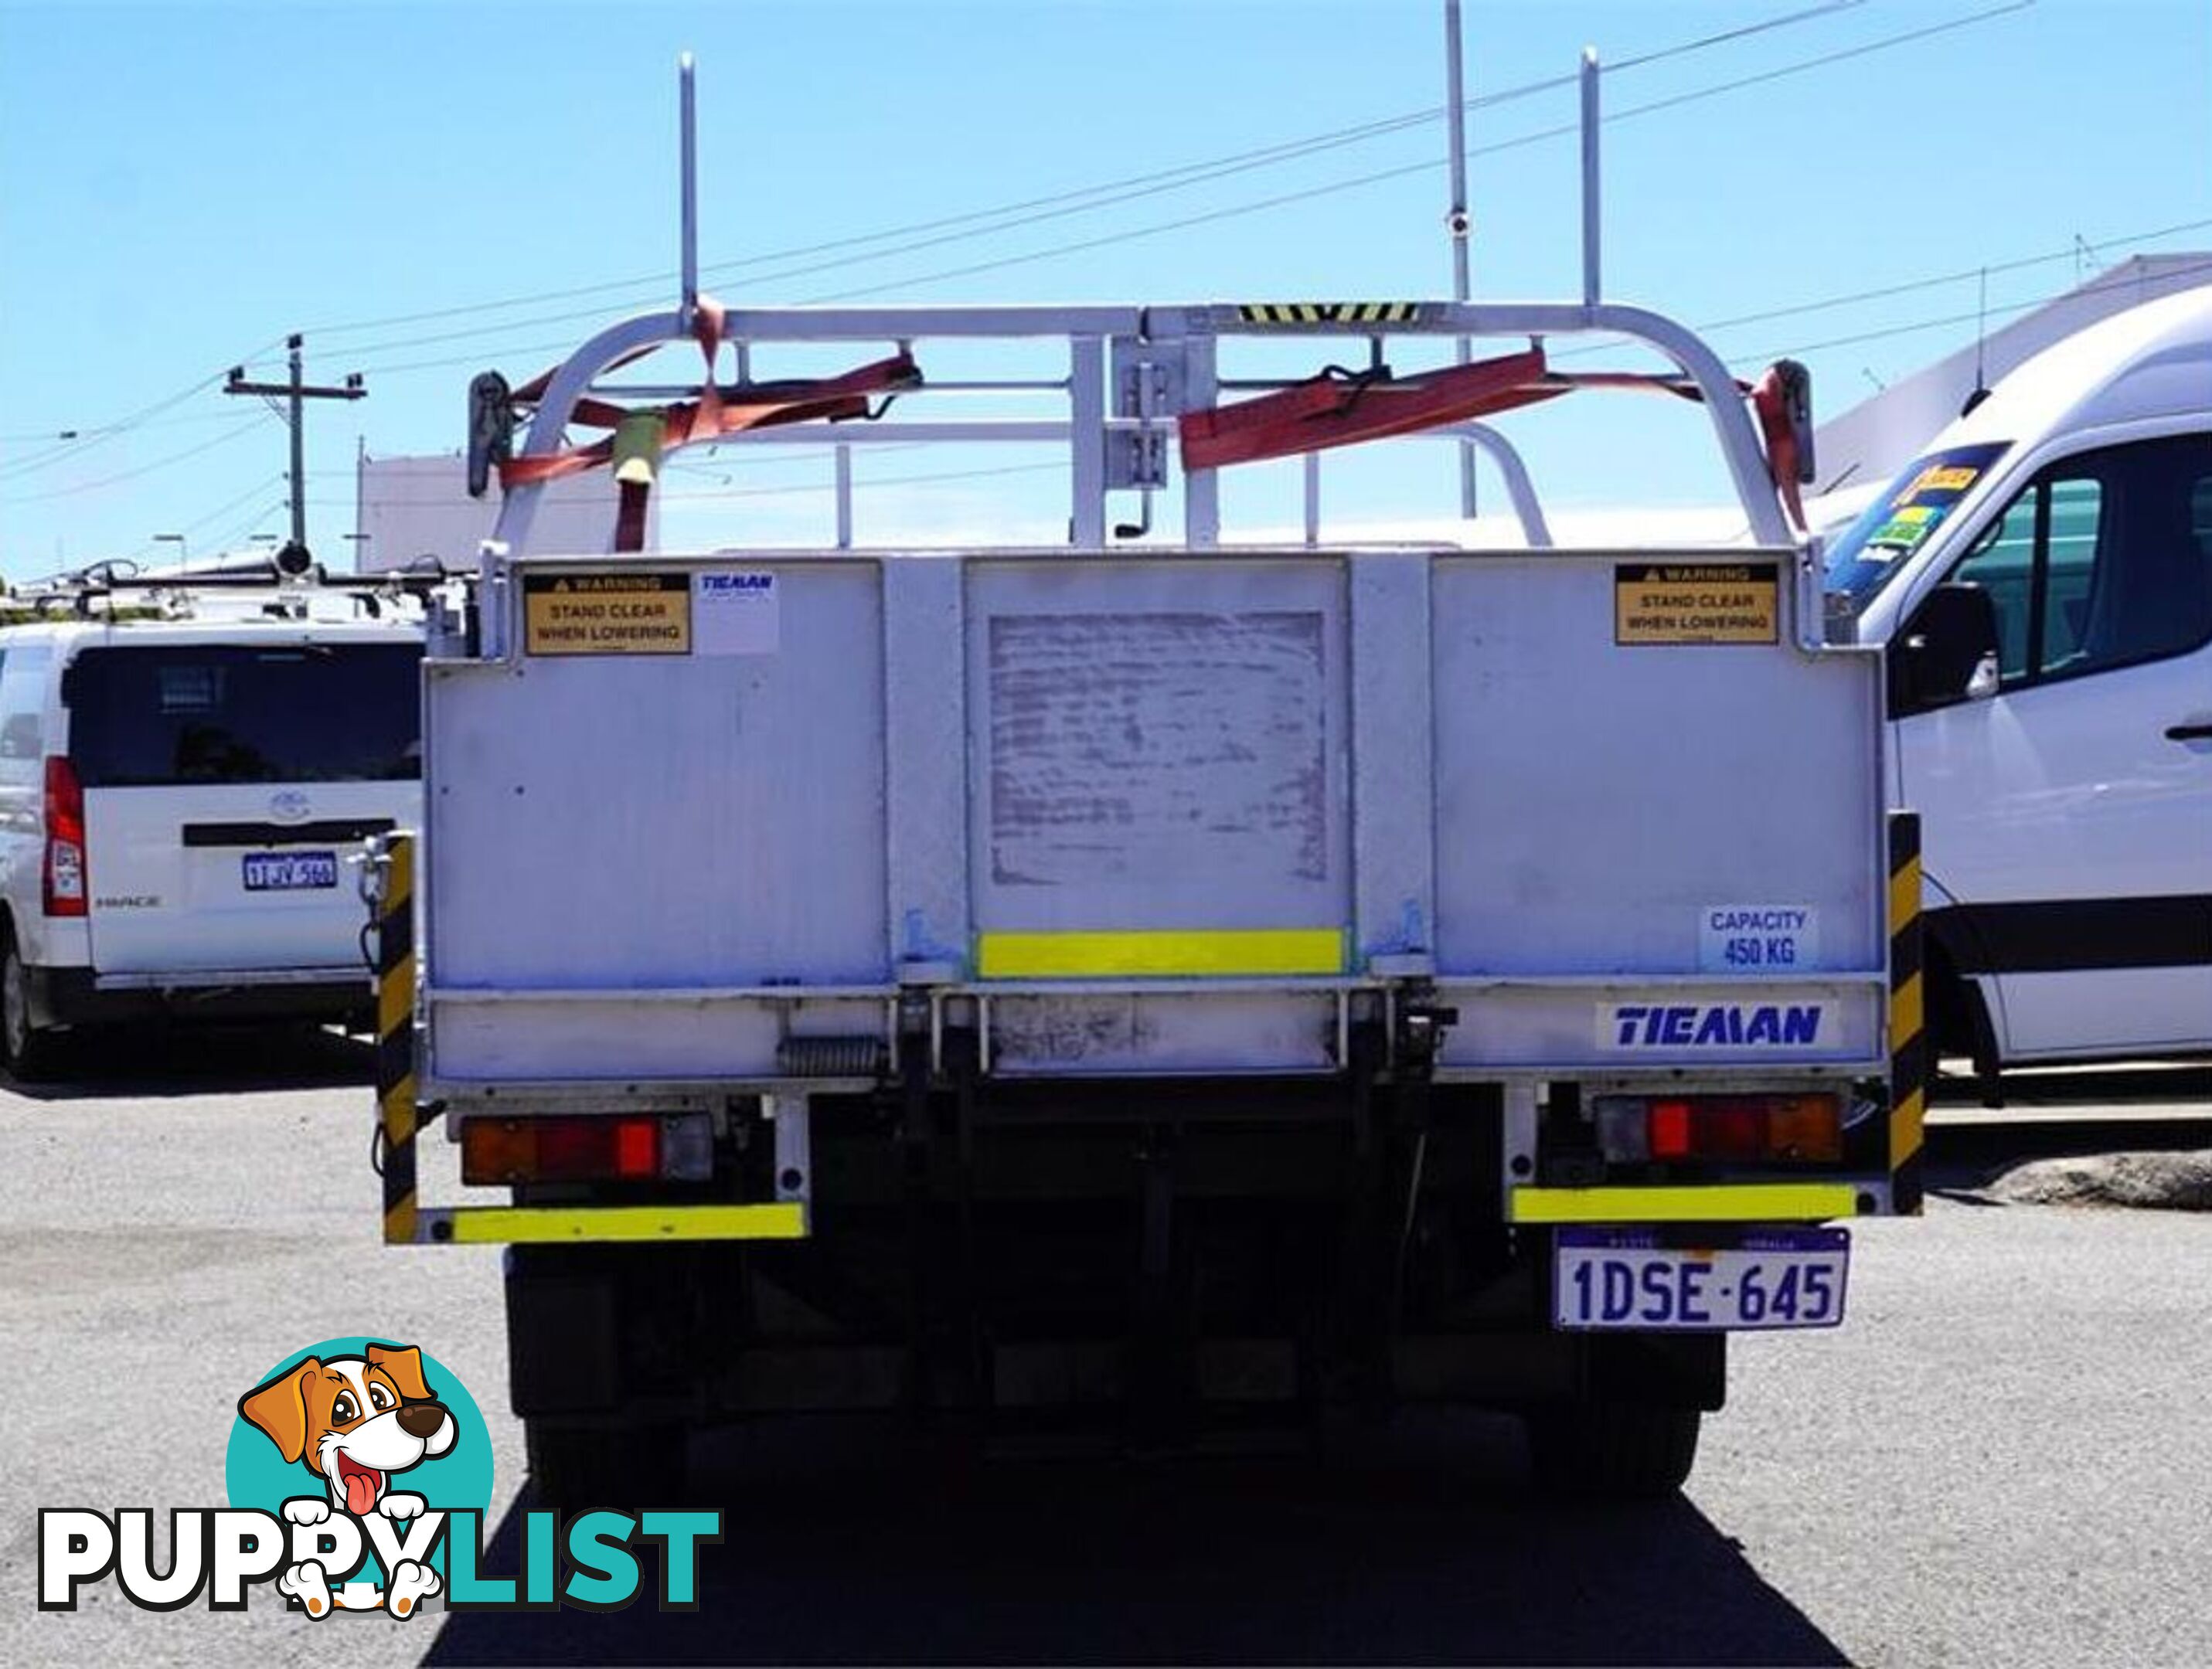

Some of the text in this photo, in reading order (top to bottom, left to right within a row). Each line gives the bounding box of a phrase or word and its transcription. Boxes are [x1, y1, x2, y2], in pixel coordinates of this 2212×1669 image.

[1666, 566, 1750, 581] WARNING
[576, 577, 662, 592] WARNING
[702, 575, 773, 589] TIEMAN
[1641, 593, 1755, 607] STAND CLEAR
[550, 604, 666, 619] STAND CLEAR
[1628, 616, 1768, 629] WHEN LOWERING
[538, 626, 679, 640] WHEN LOWERING
[1710, 911, 1806, 931] CAPACITY
[1724, 938, 1795, 964] 450 KG
[1615, 1007, 1821, 1045] TIEMAN
